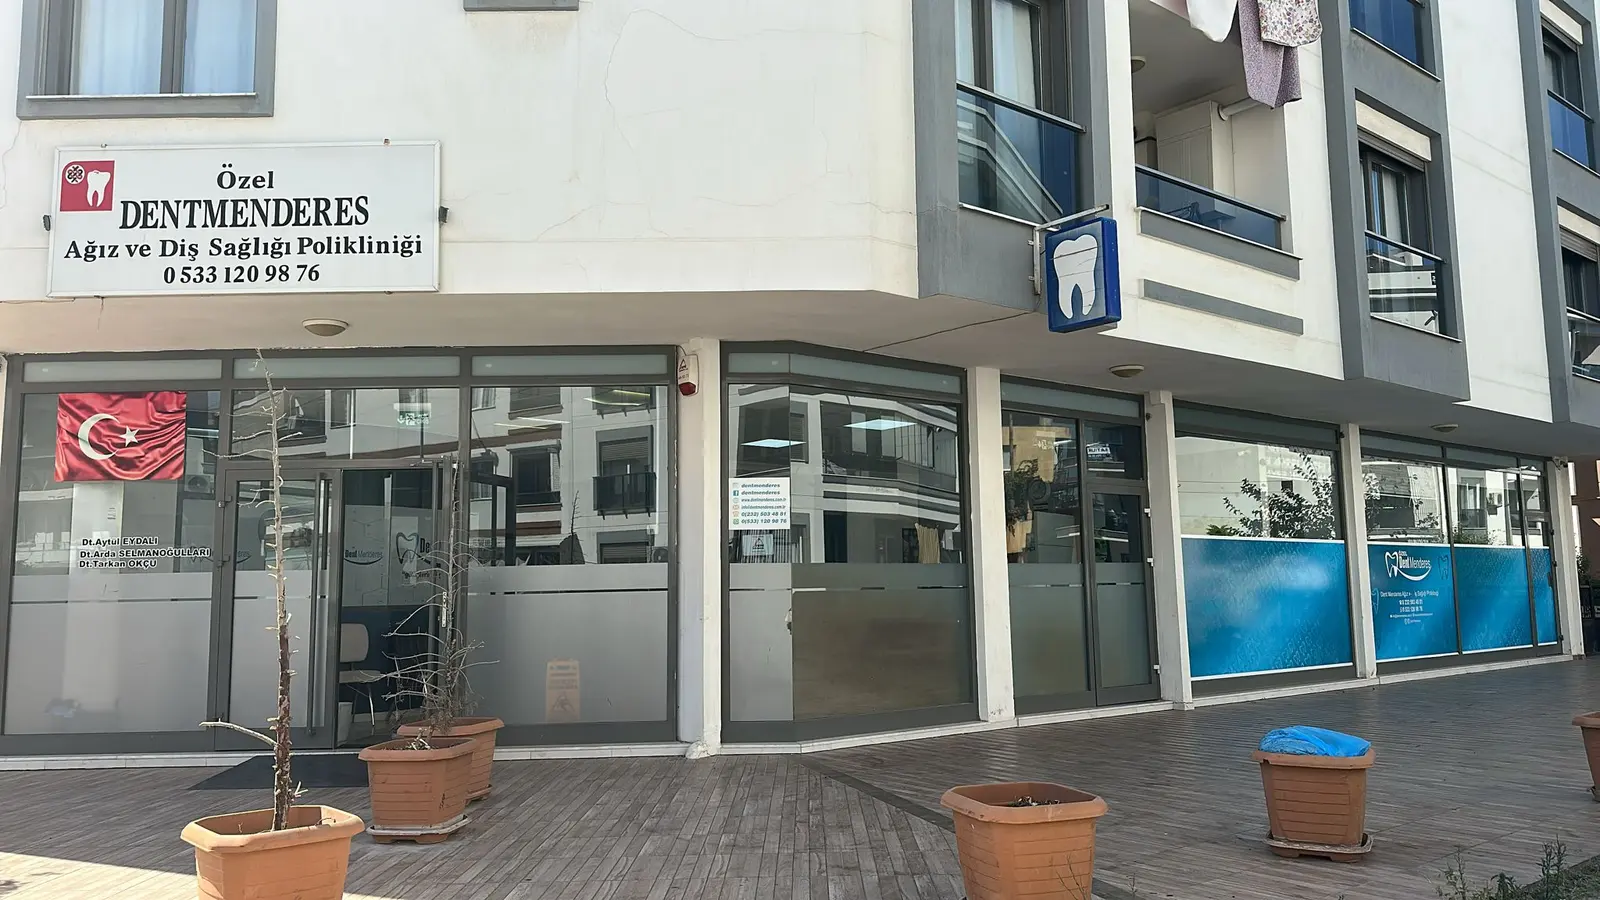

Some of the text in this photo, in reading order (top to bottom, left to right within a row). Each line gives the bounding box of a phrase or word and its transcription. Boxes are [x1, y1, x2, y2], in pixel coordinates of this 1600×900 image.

[217, 163, 274, 190] Özel
[119, 195, 370, 230] DENTMENDERES
[64, 234, 423, 262] Ağız ve Diş Sağlığı Polikliniği
[163, 263, 320, 284] 0 533 120 98 76
[118, 547, 212, 559] SELMANOĞULLARI
[1410, 557, 1431, 568] Menderes
[128, 559, 157, 570] OKÇU
